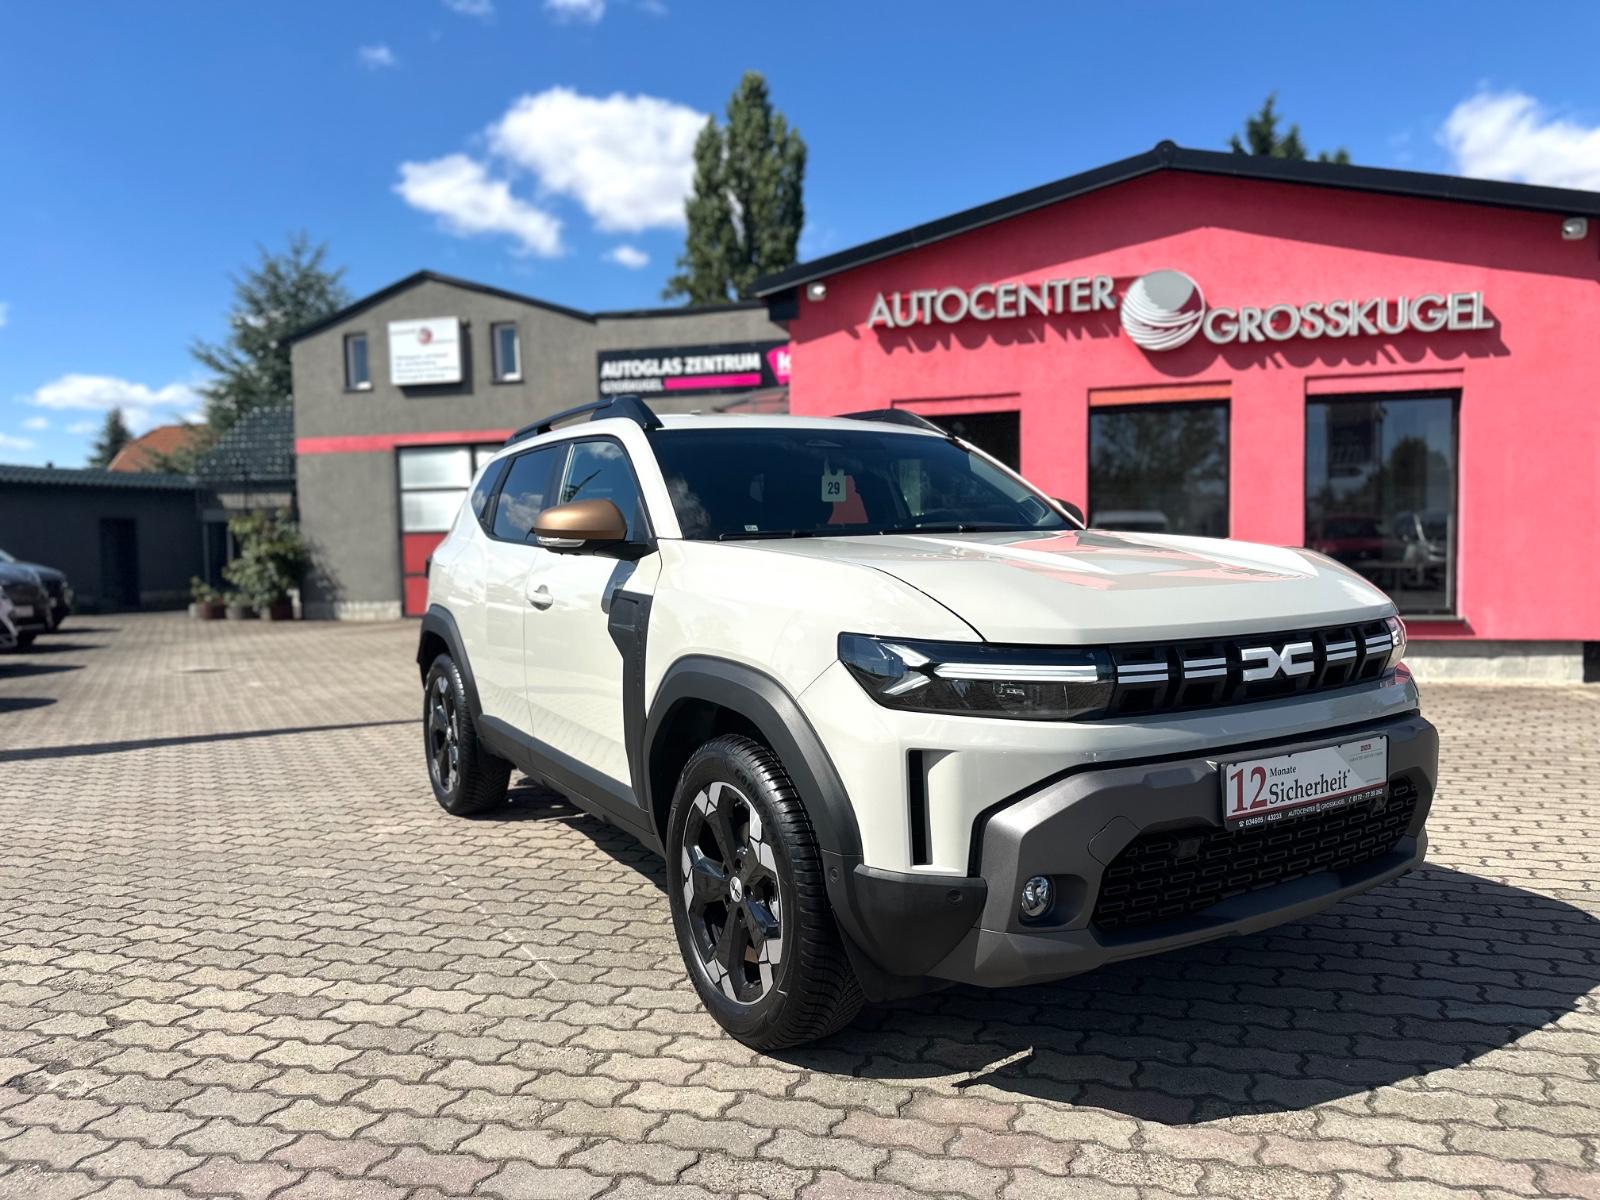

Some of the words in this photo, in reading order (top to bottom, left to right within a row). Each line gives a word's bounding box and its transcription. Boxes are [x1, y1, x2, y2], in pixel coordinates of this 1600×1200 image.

[866, 276, 1116, 328] AUTOCENTER
[1202, 291, 1495, 344] GROSSKUGEL
[601, 357, 682, 378] AUTOGLAS
[684, 353, 762, 374] ZENTRUM
[828, 482, 840, 495] 29
[1230, 766, 1268, 813] 12
[1269, 766, 1297, 777] Monate
